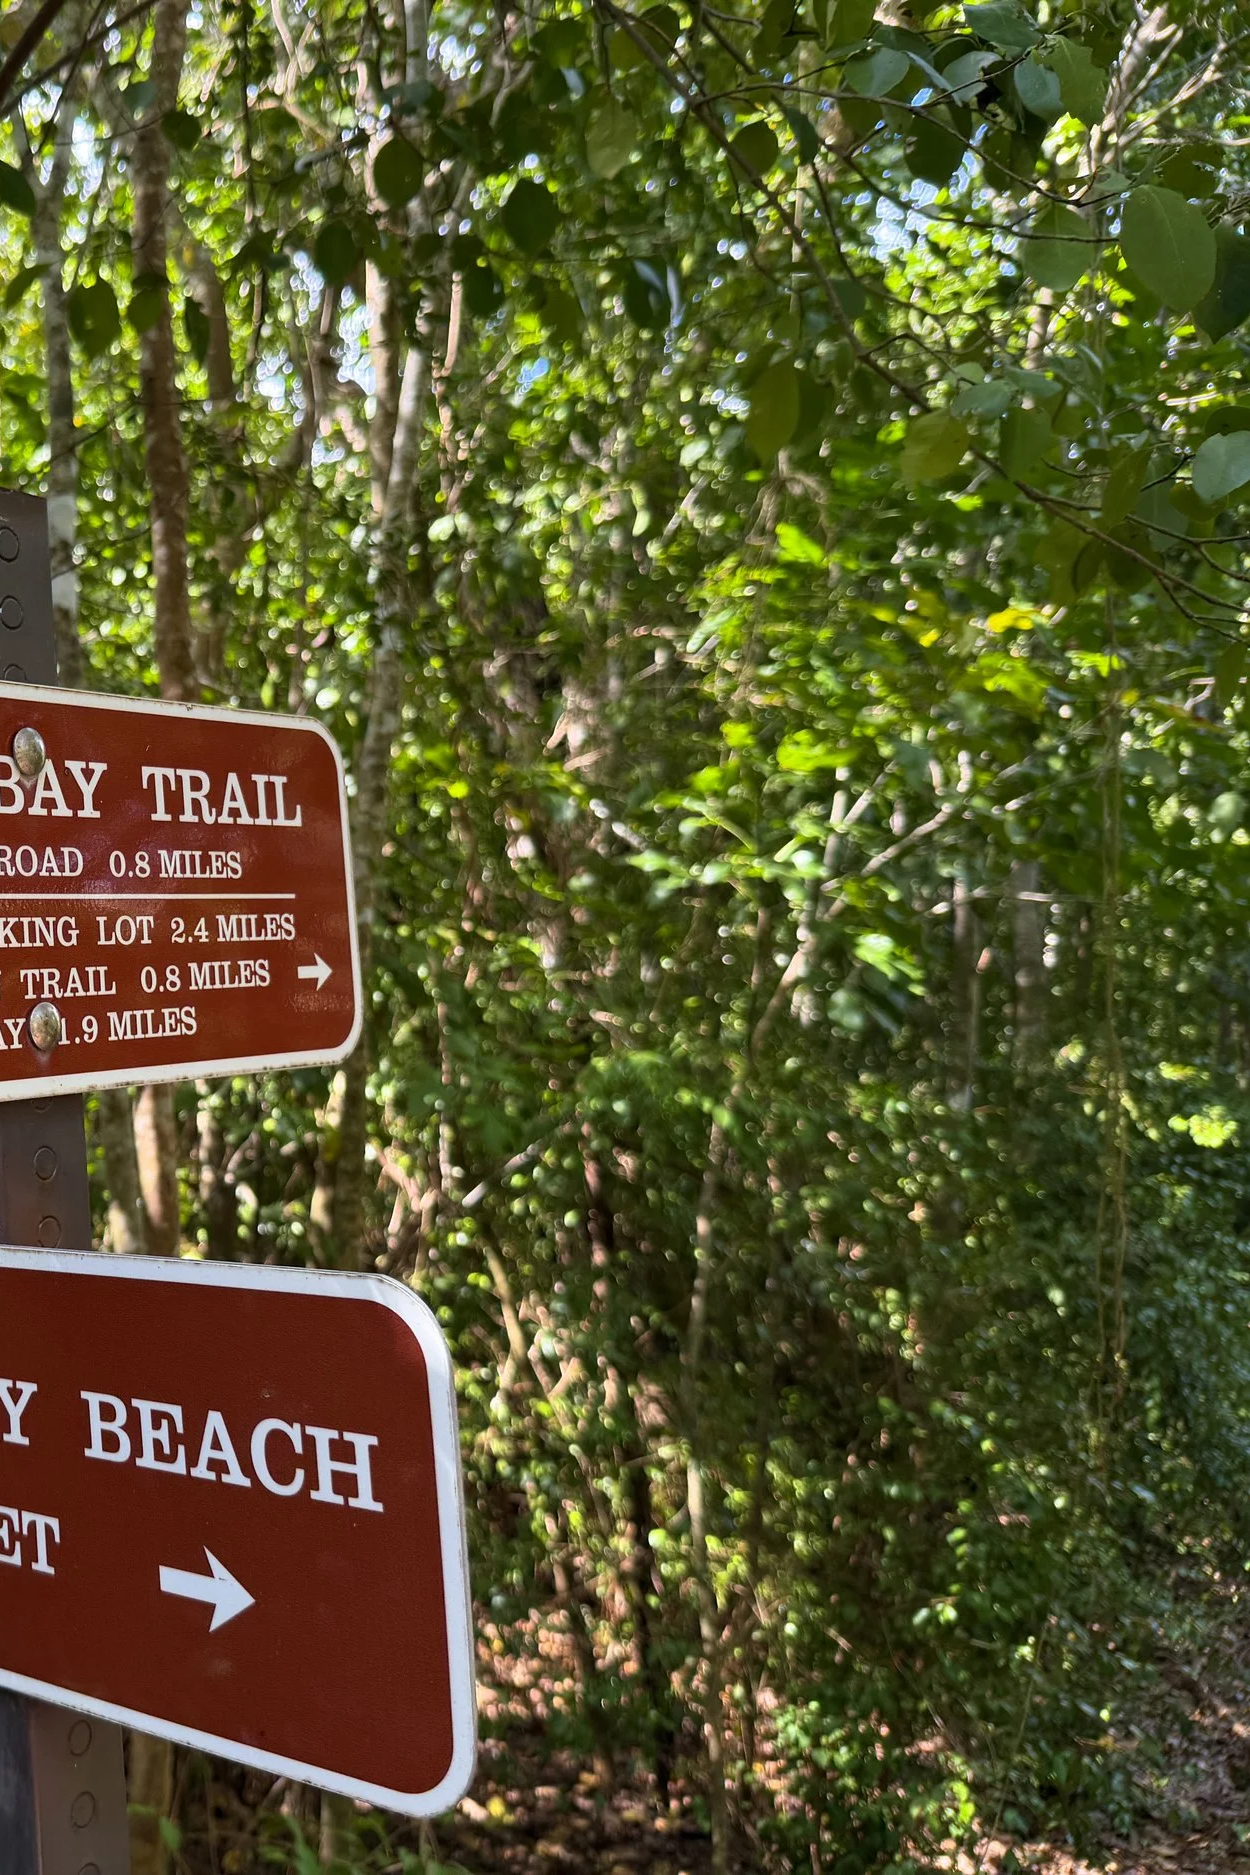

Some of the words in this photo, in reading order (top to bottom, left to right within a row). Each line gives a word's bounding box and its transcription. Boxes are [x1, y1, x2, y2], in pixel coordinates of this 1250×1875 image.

[142, 766, 302, 827] TRAIL
[110, 851, 150, 878] 0.8
[158, 850, 242, 879] MILES
[96, 915, 154, 945] LOT
[171, 917, 209, 943] 2.4
[216, 913, 295, 941] MILES
[20, 966, 116, 999] TRAIL
[141, 965, 181, 993] 0.8
[188, 959, 270, 990] MILES
[58, 1015, 98, 1045] 1.9
[107, 1006, 197, 1041] MILES
[81, 1391, 383, 1512] BEACH
